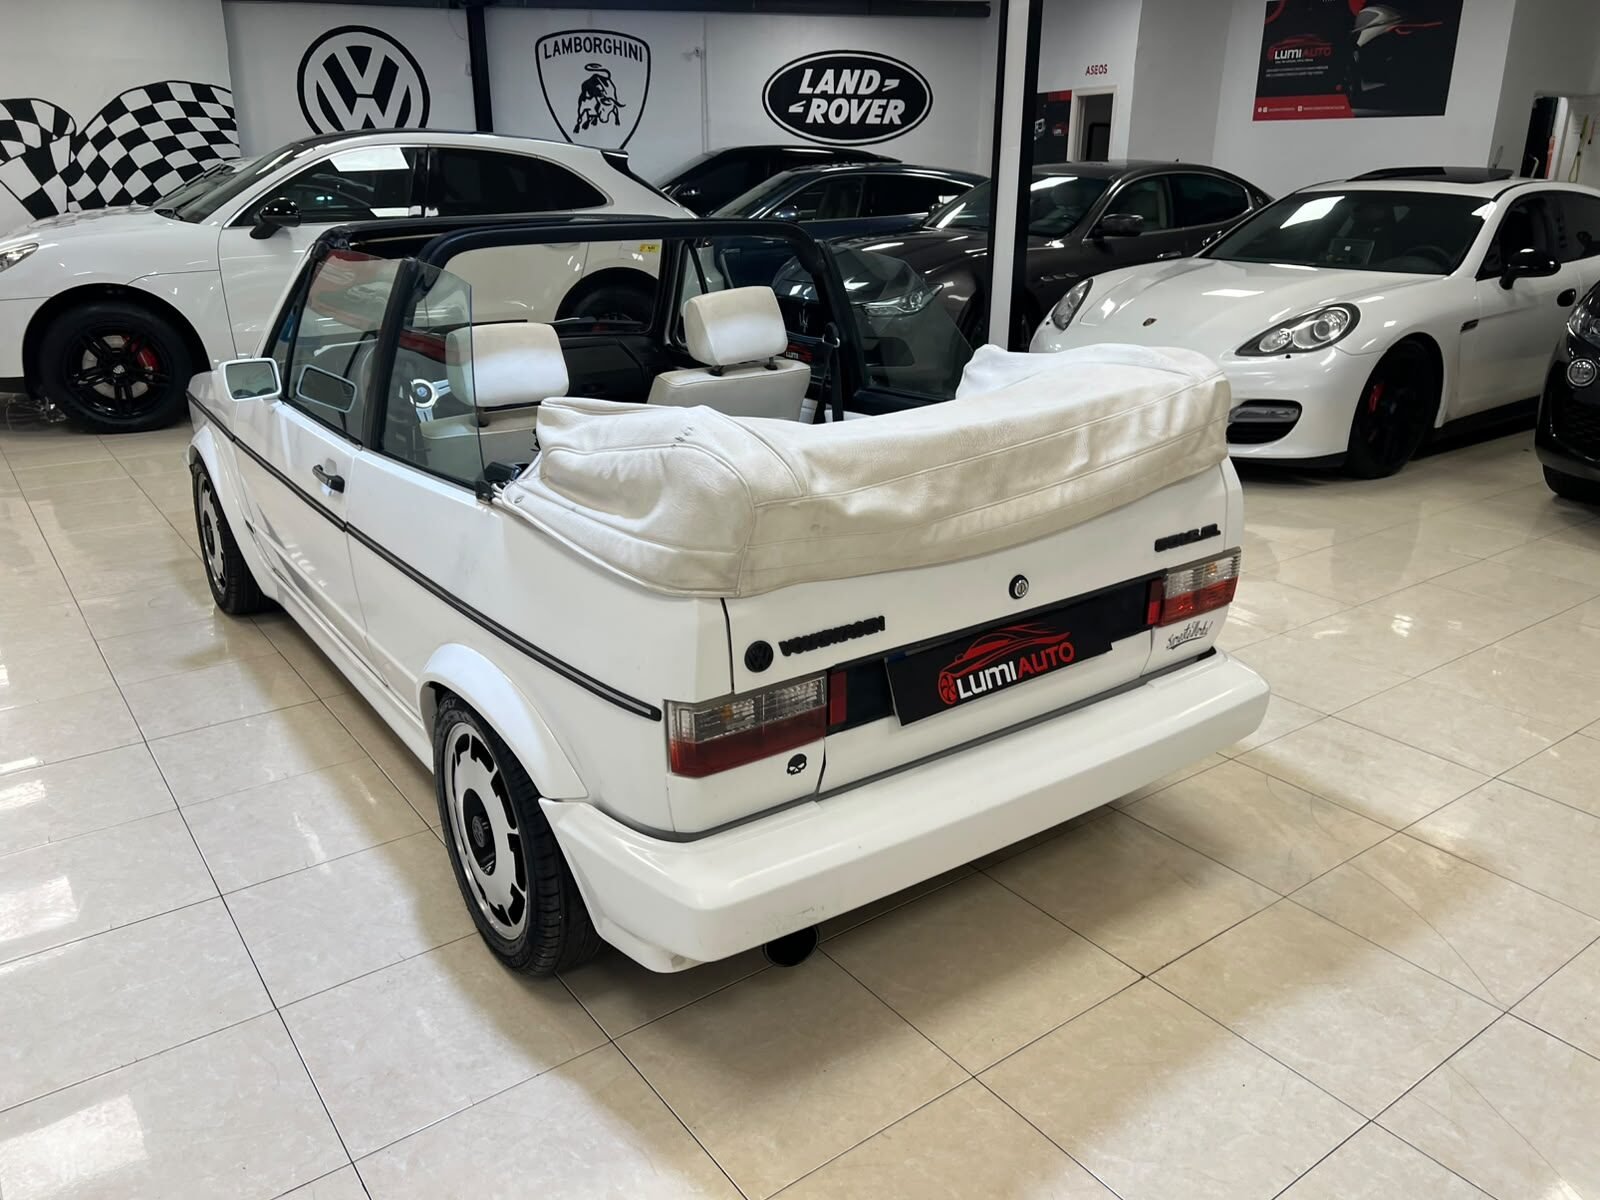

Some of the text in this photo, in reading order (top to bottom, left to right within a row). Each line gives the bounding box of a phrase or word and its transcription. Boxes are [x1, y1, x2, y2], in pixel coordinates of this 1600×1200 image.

[543, 36, 643, 62] LAMBORGHINI
[798, 68, 881, 95] LAND
[1085, 64, 1108, 76] ASEOS
[805, 98, 906, 125] ROVER
